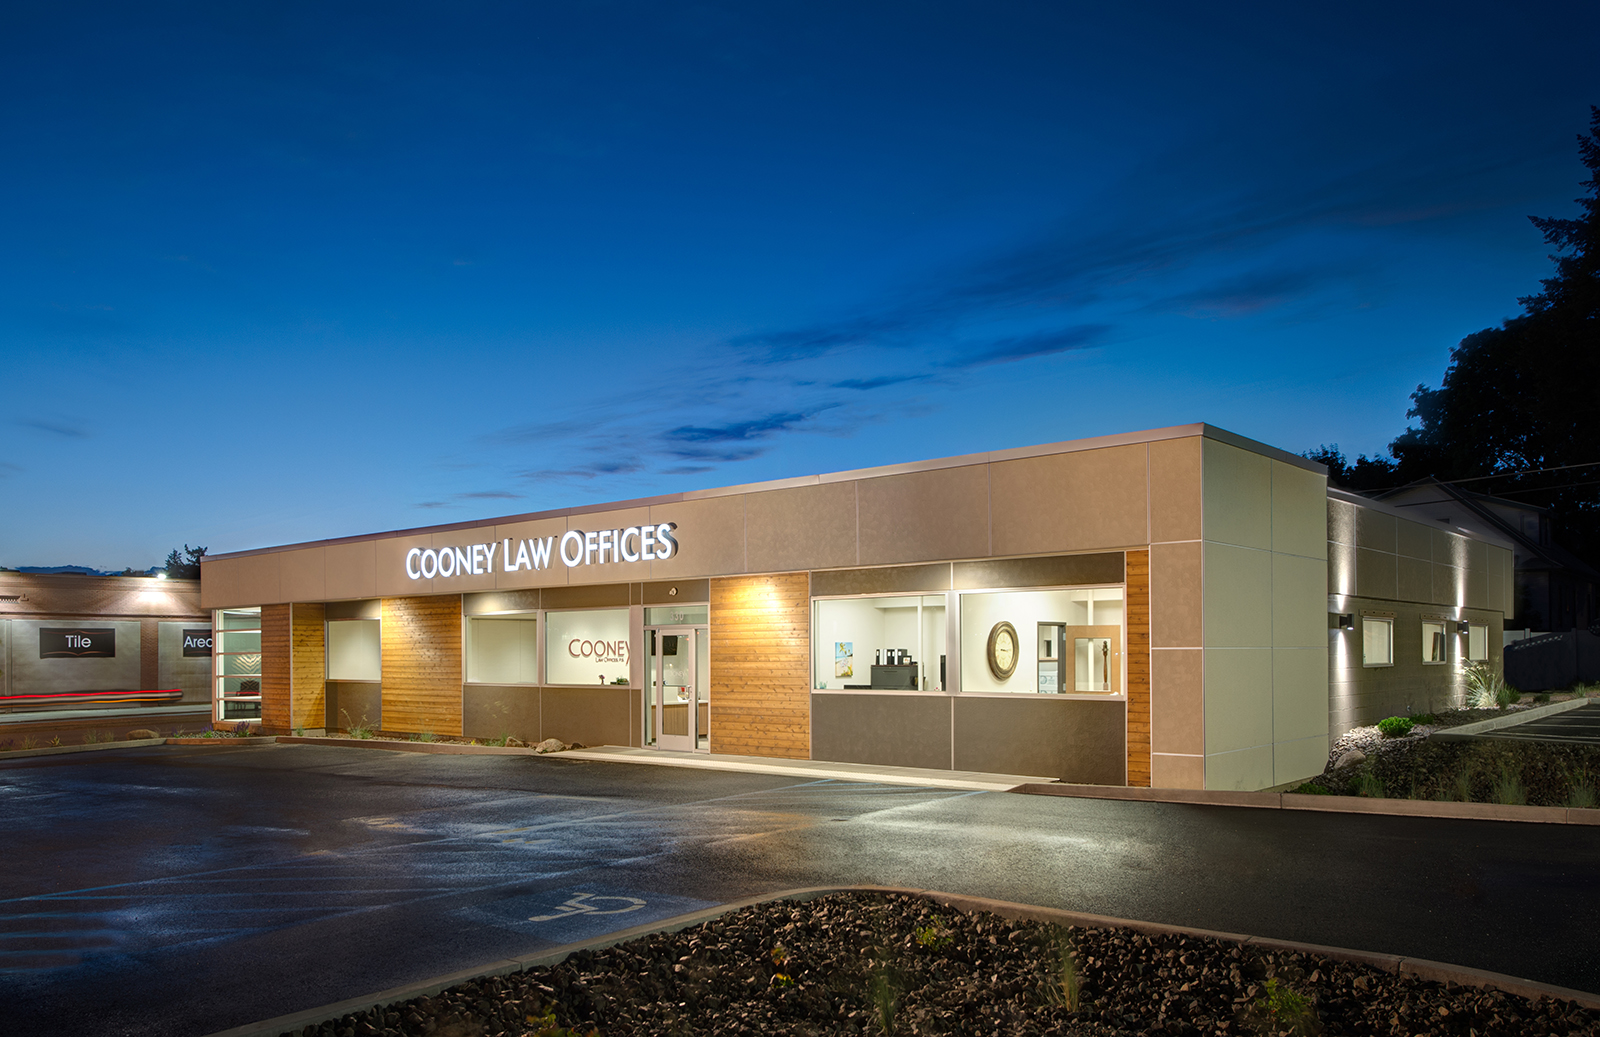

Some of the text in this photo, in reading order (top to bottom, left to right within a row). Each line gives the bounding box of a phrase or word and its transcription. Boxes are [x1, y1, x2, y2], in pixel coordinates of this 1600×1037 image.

[405, 523, 673, 580] COONEY LAW OFFICES
[670, 611, 683, 621] 330
[65, 635, 92, 648] Tile
